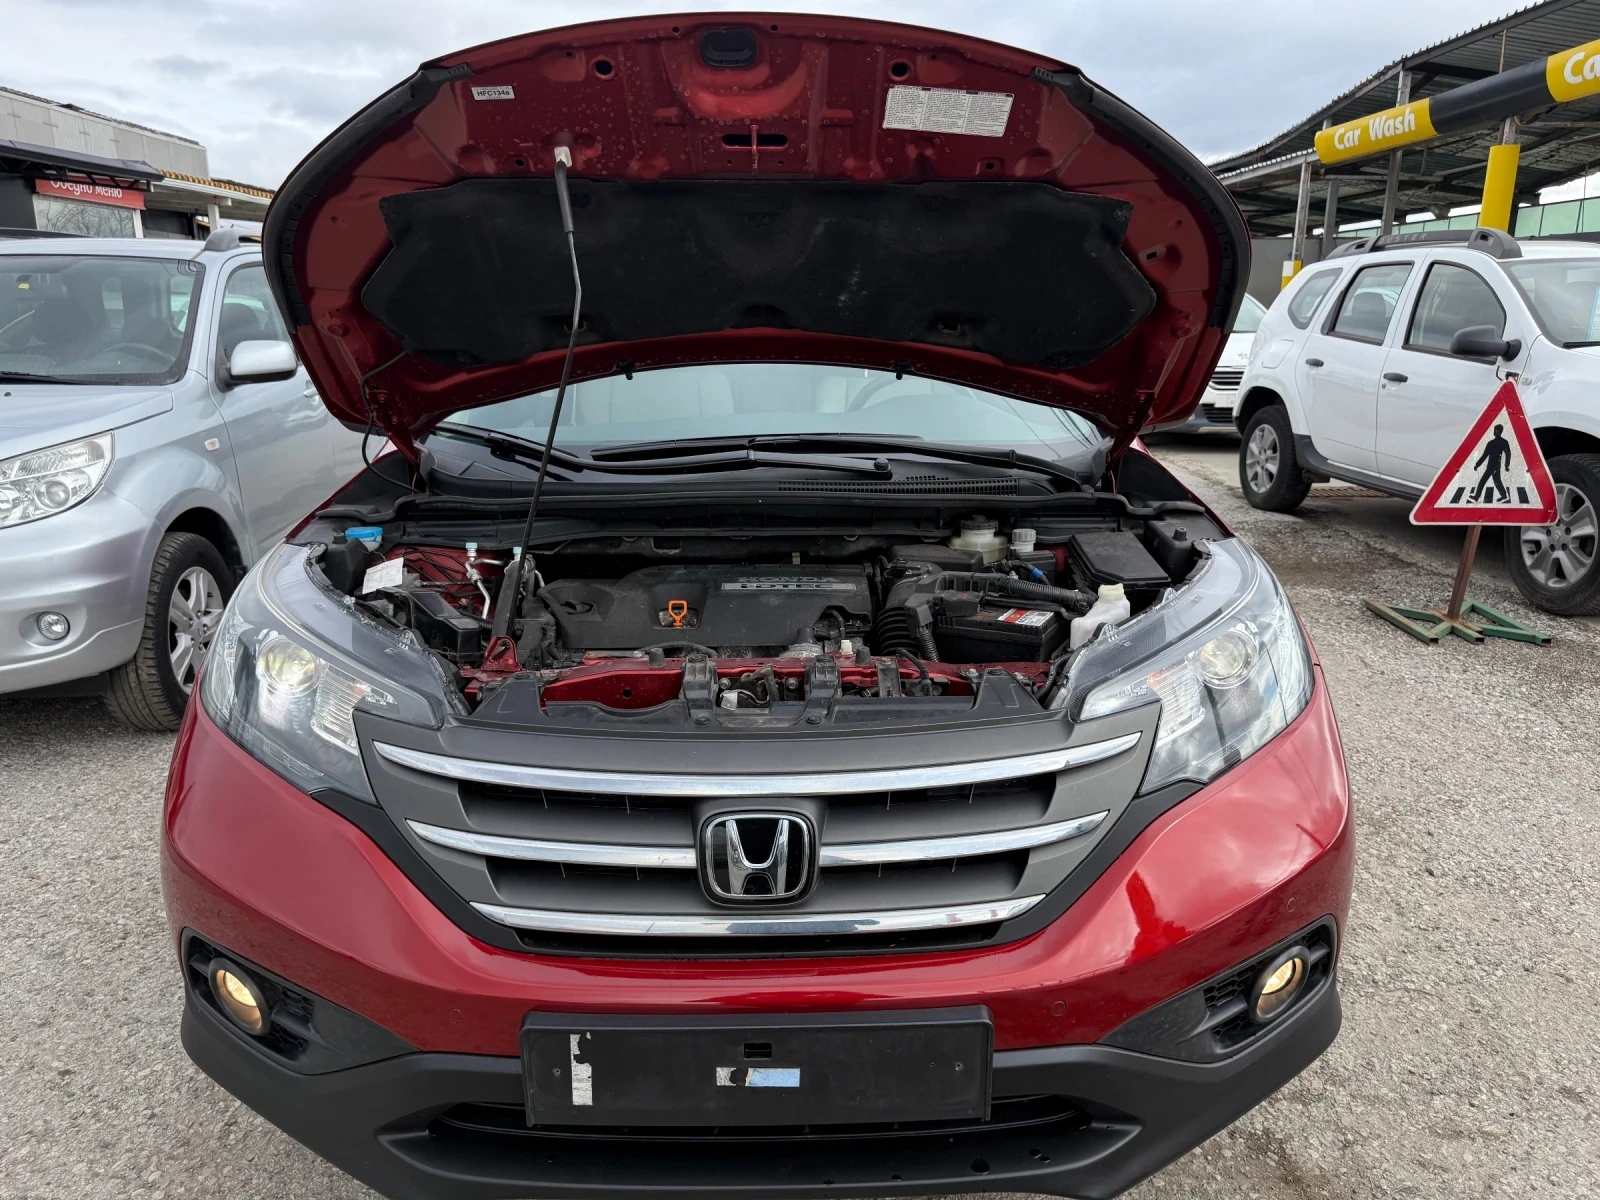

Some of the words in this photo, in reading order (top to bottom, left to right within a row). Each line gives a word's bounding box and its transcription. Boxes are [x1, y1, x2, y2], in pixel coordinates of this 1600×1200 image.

[1333, 127, 1361, 150] Car
[1369, 107, 1416, 141] Wash
[1379, 232, 1428, 245] DUSTER
